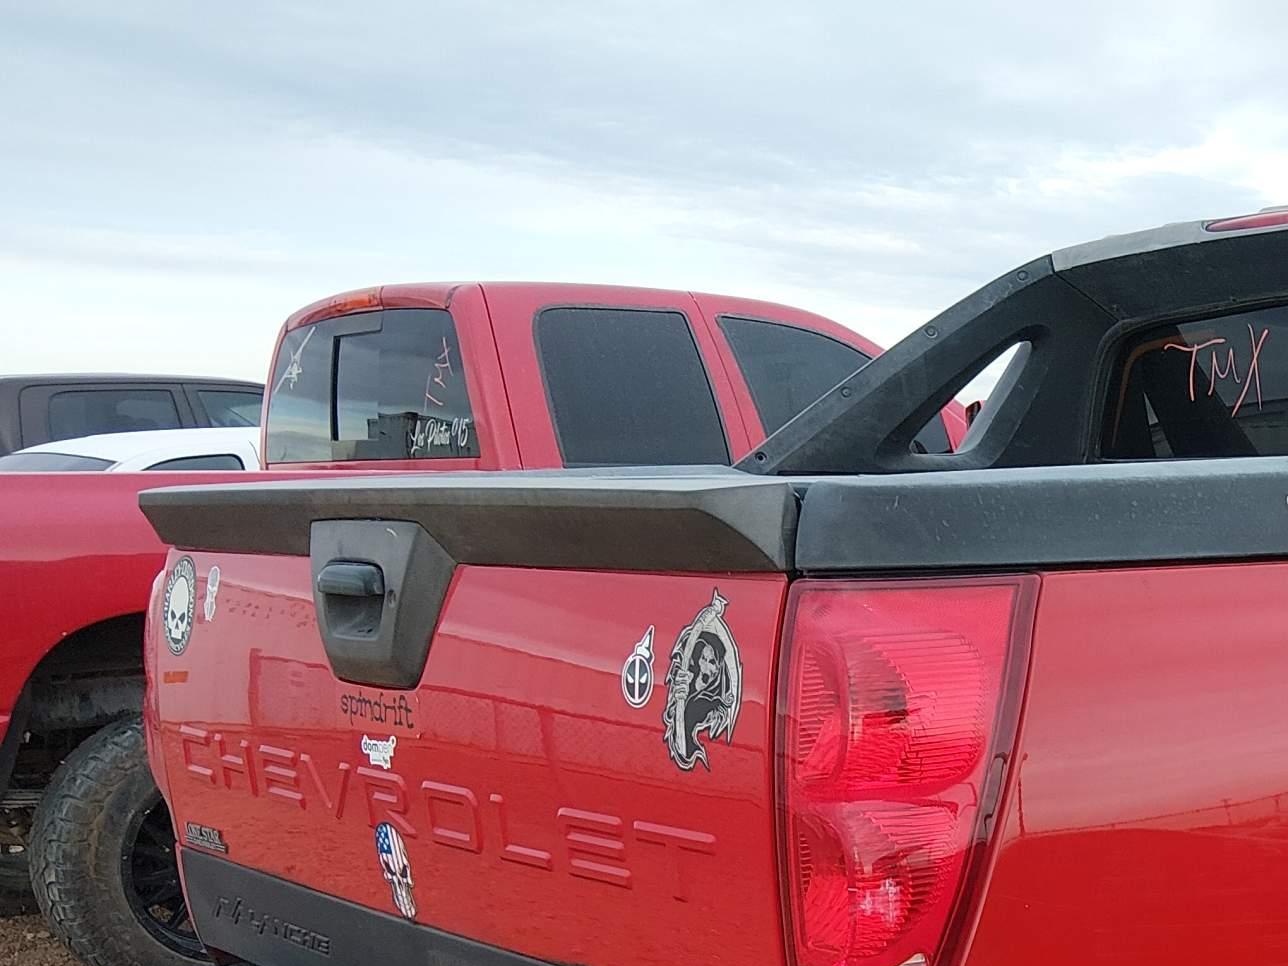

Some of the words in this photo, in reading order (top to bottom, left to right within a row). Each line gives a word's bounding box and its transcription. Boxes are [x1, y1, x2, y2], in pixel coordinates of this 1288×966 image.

[1163, 324, 1270, 419] TMX
[340, 689, 415, 729] spindrift
[180, 724, 717, 902] CHEVROLET
